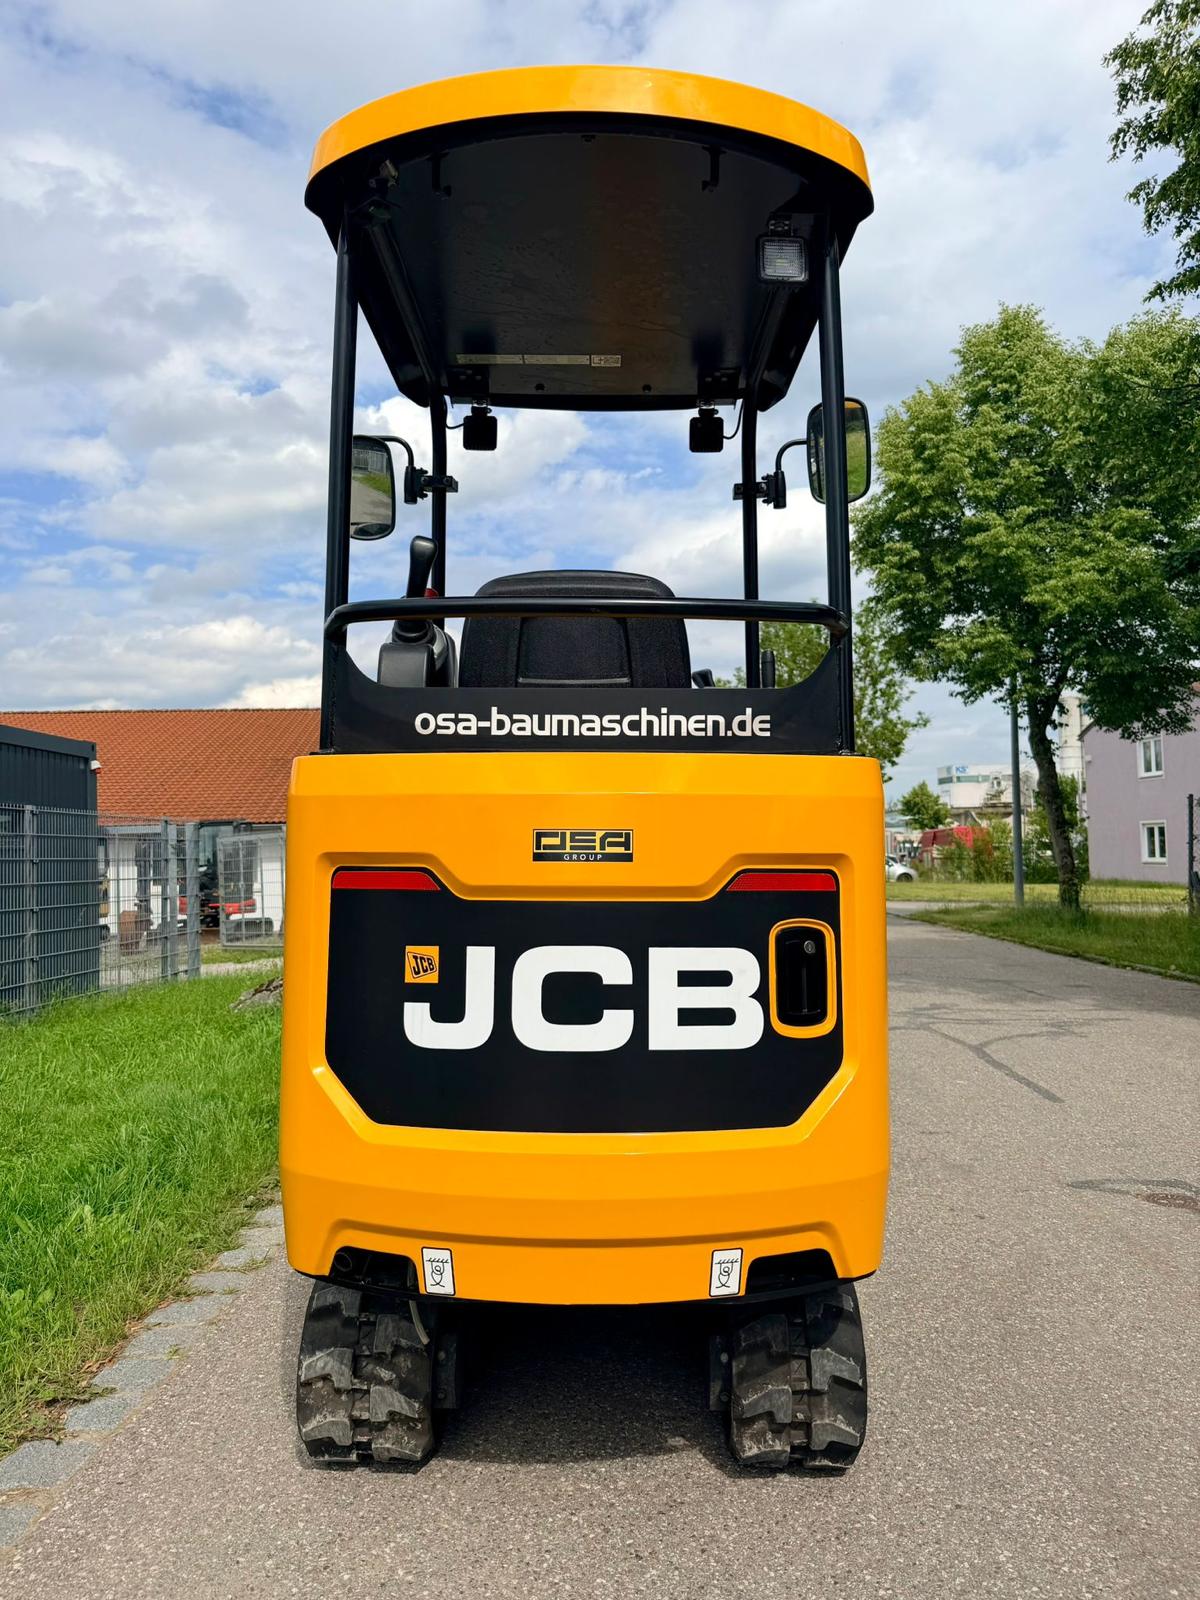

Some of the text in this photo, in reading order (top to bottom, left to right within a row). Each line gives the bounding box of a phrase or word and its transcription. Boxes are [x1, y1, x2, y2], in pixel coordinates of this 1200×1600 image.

[414, 706, 771, 737] osa-baumaschinen.de
[563, 853, 603, 861] GROUP
[412, 954, 435, 976] JCB
[403, 945, 765, 1052] JCB
